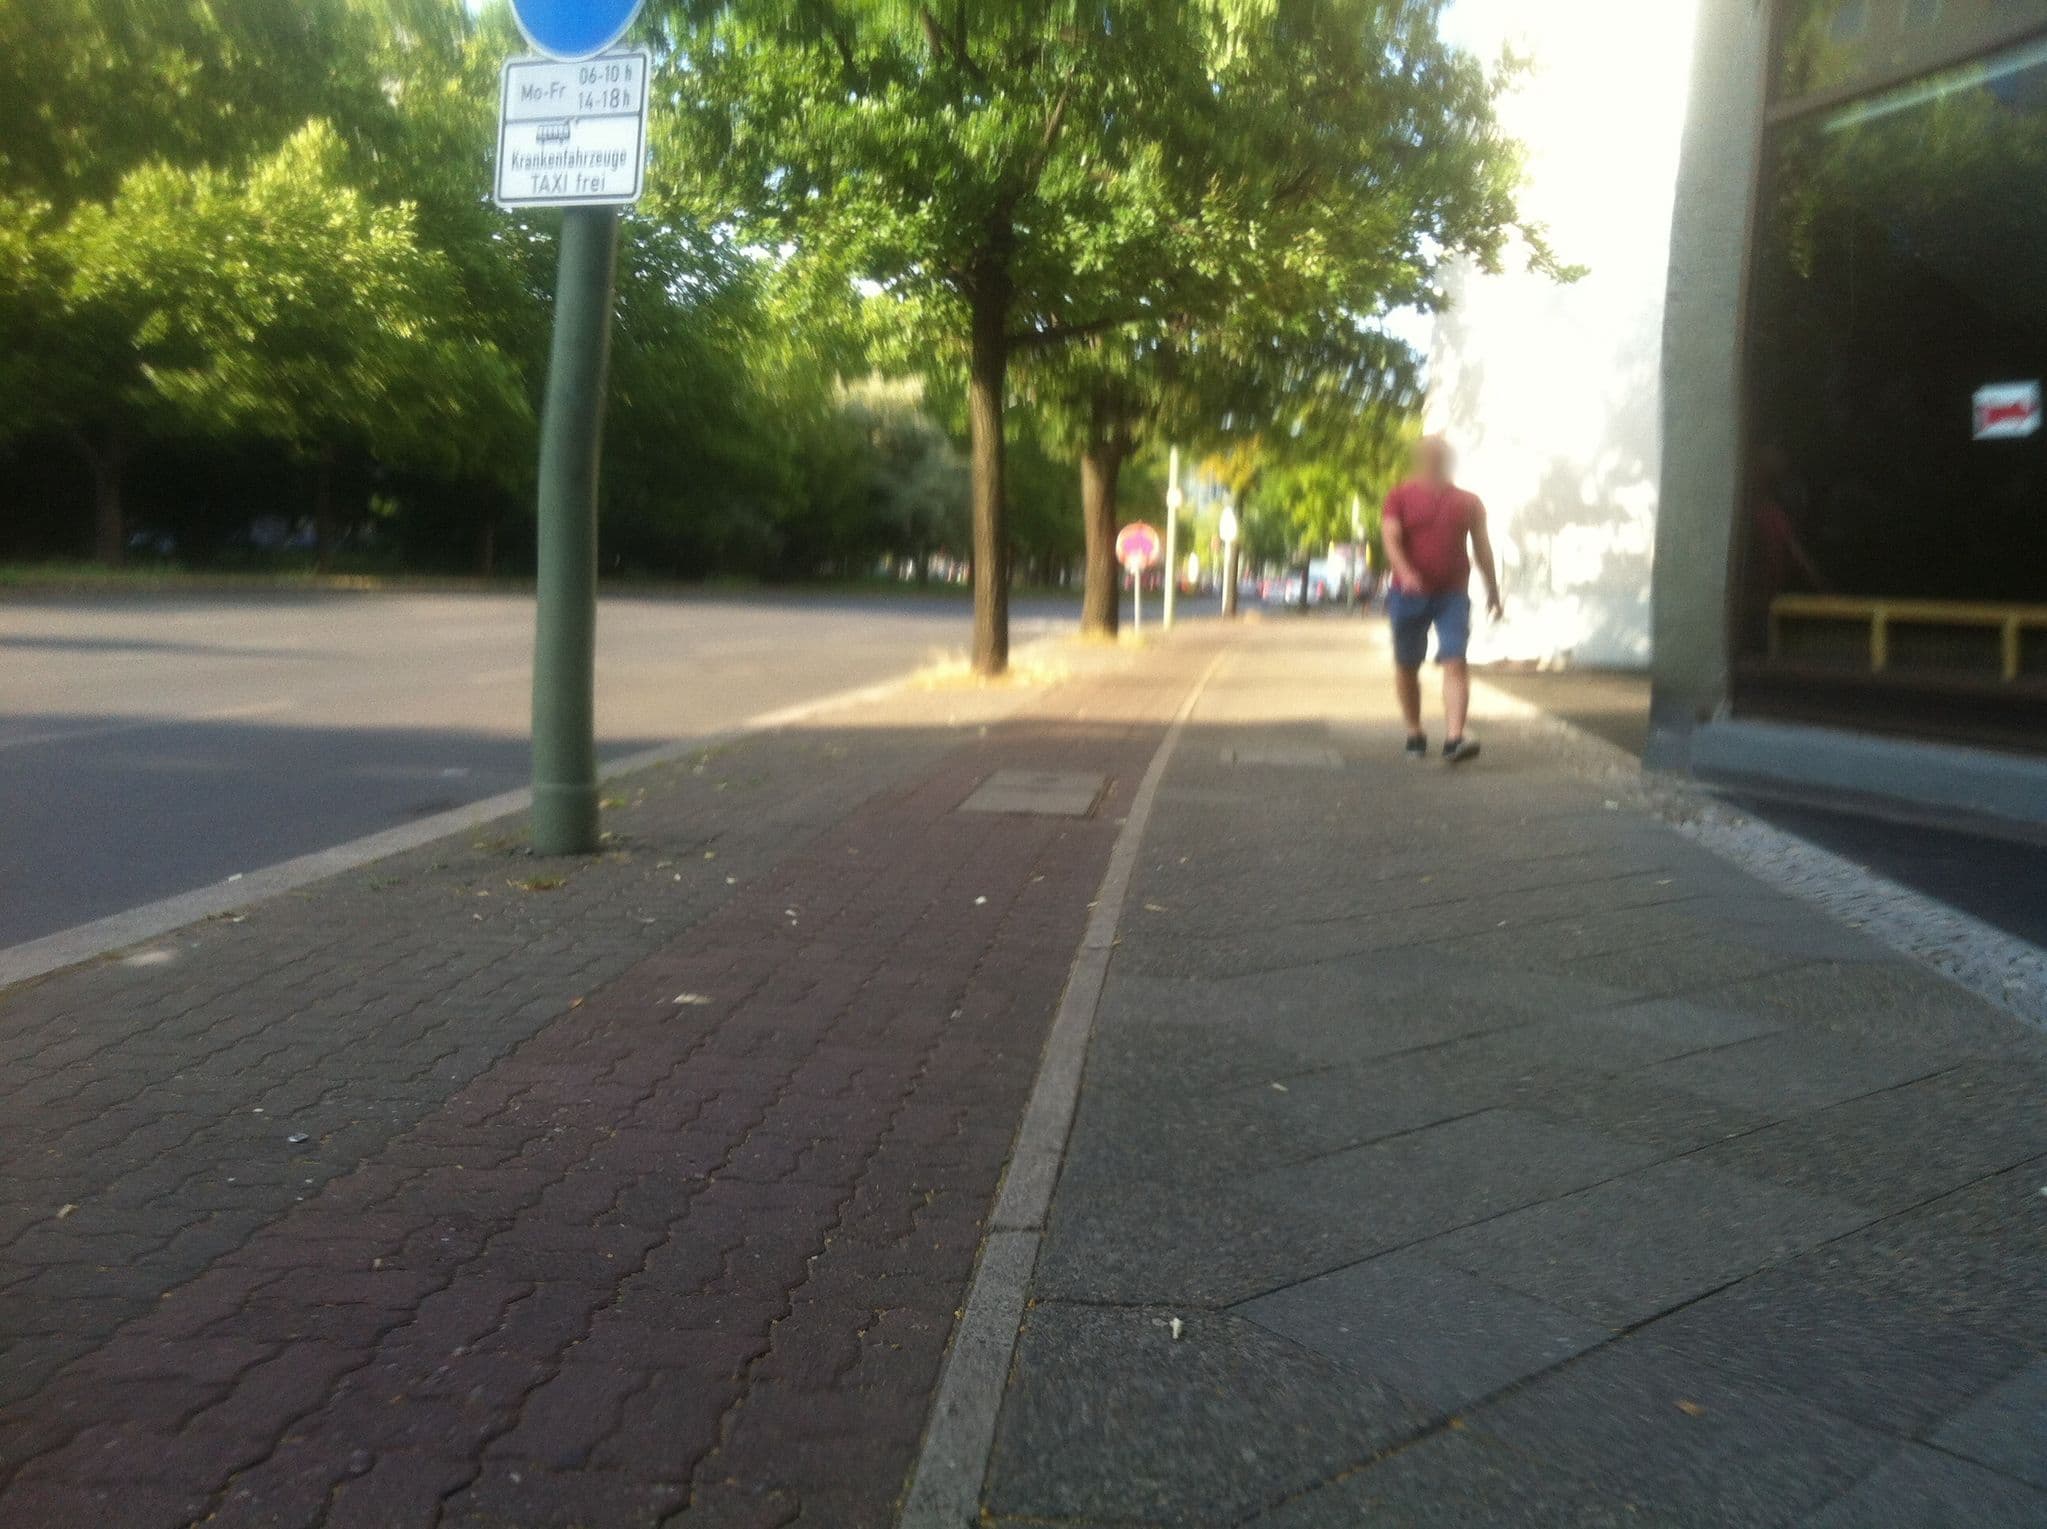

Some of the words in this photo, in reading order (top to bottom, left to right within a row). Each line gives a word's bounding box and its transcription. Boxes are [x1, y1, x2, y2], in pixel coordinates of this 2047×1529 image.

[512, 147, 627, 172] Krankenfahrzeuge
[531, 173, 568, 194] TAXI
[576, 172, 606, 193] frei
